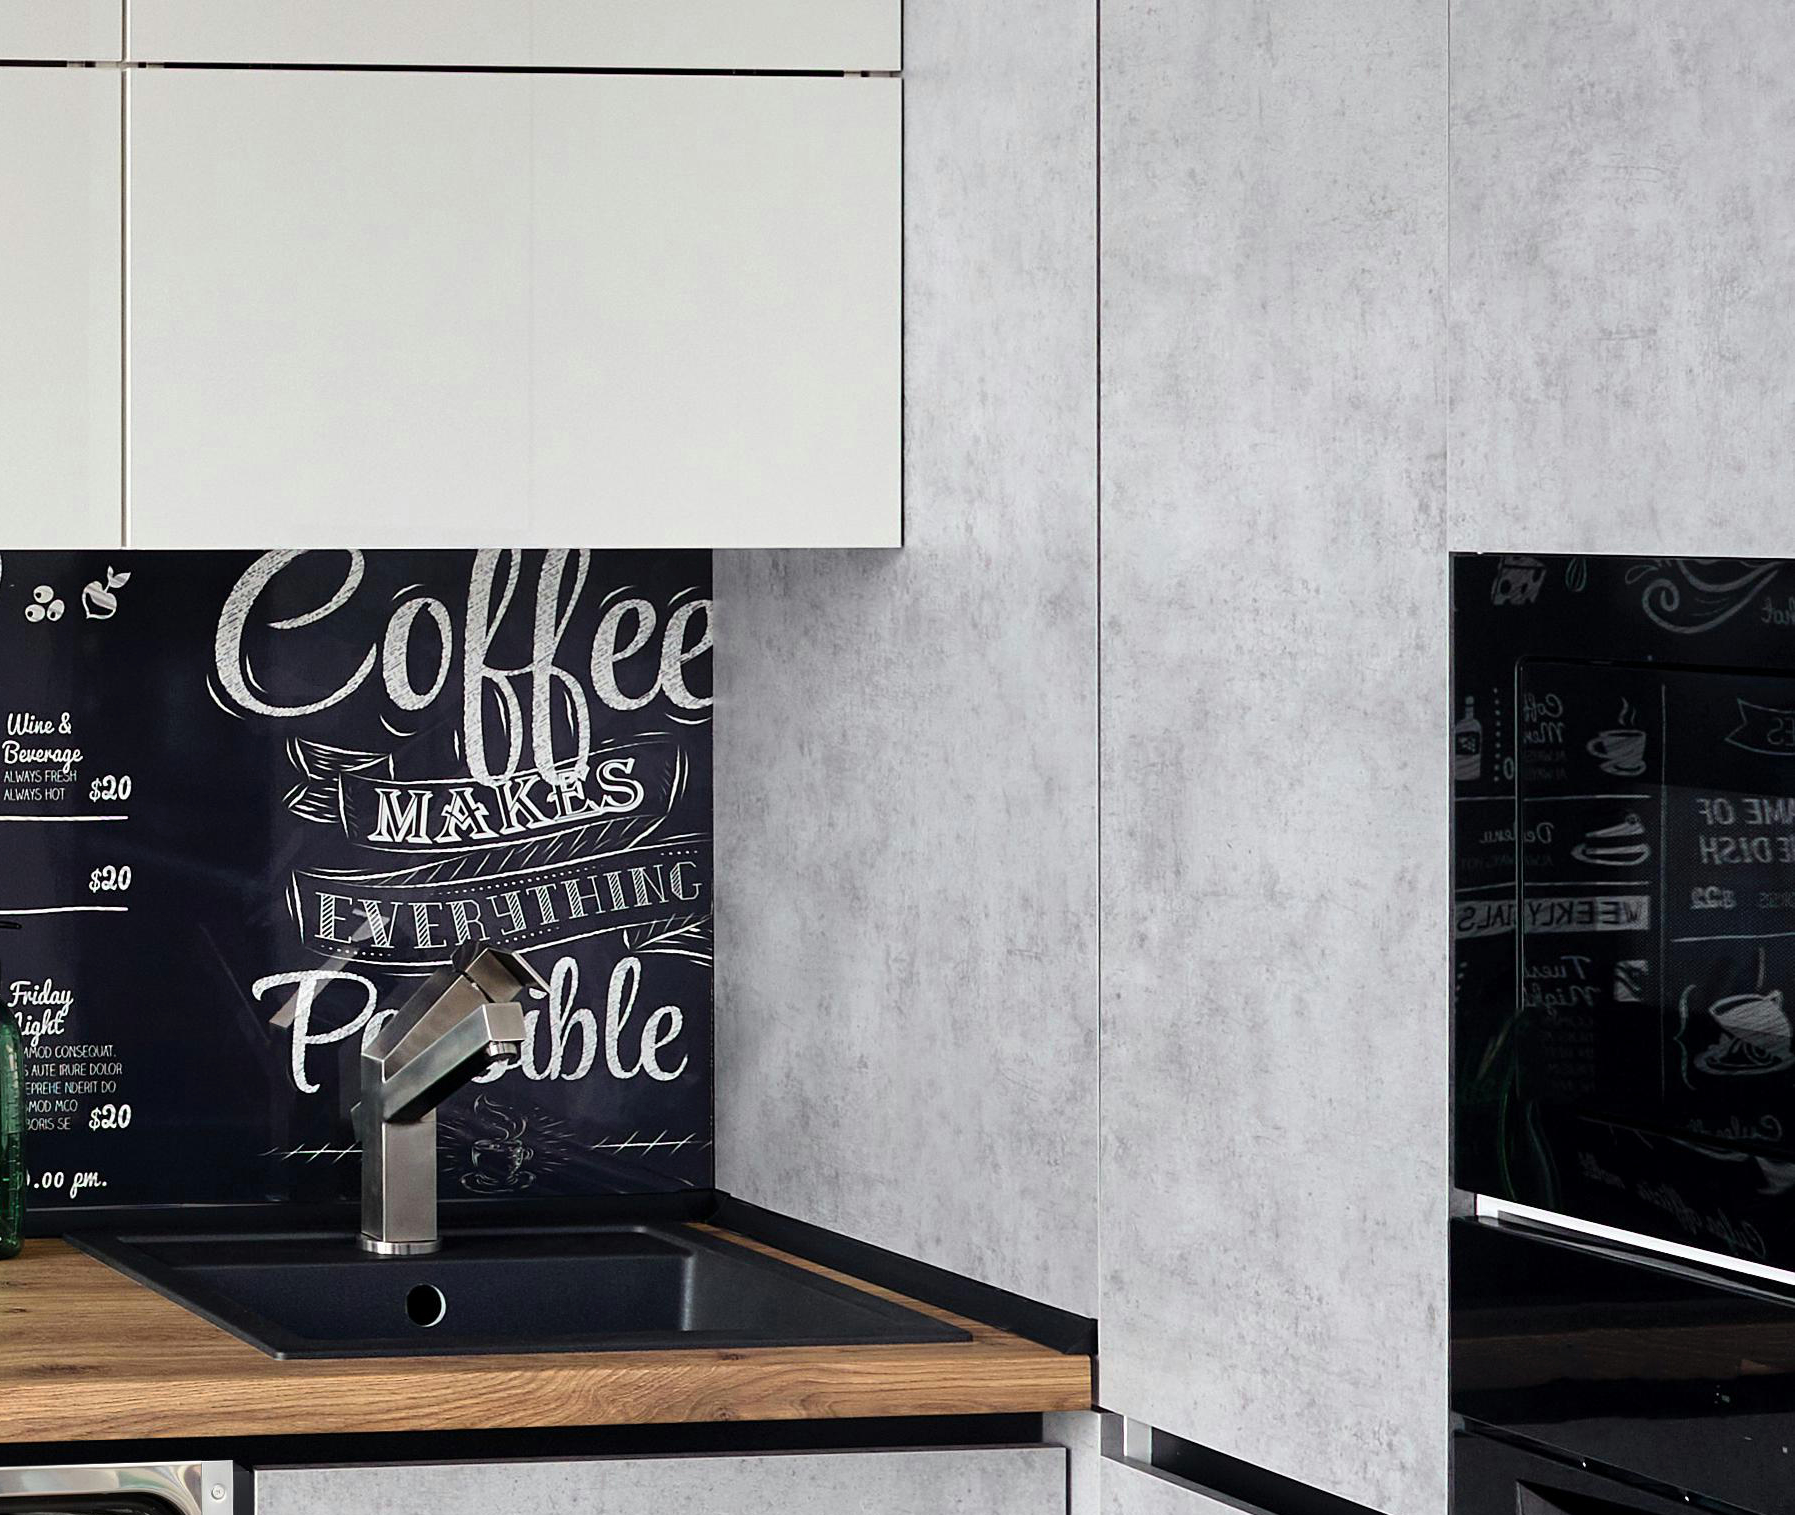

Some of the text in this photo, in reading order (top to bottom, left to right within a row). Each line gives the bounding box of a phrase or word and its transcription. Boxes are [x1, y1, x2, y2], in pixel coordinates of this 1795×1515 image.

[214, 549, 713, 788] Coffee
[7, 711, 72, 738] Wine &
[2, 740, 83, 774] Beverage
[3, 769, 77, 783] ALWAYS FRESH
[3, 775, 132, 802] ALWAYS HOT $20
[367, 757, 645, 846] MAKES
[89, 866, 132, 892] $20
[314, 860, 702, 950] EVERYTHING
[7, 978, 74, 1017] Friday
[31, 1063, 56, 1076] AUTE
[59, 1062, 86, 1076] IRURE
[90, 1062, 122, 1075] DOLOR
[65, 1081, 98, 1094] NDERIT
[101, 1081, 116, 1093] DO
[54, 1100, 78, 1112] MCO
[57, 1117, 71, 1130] SE
[88, 1104, 132, 1131] $20
[70, 1171, 107, 1199] pm.
